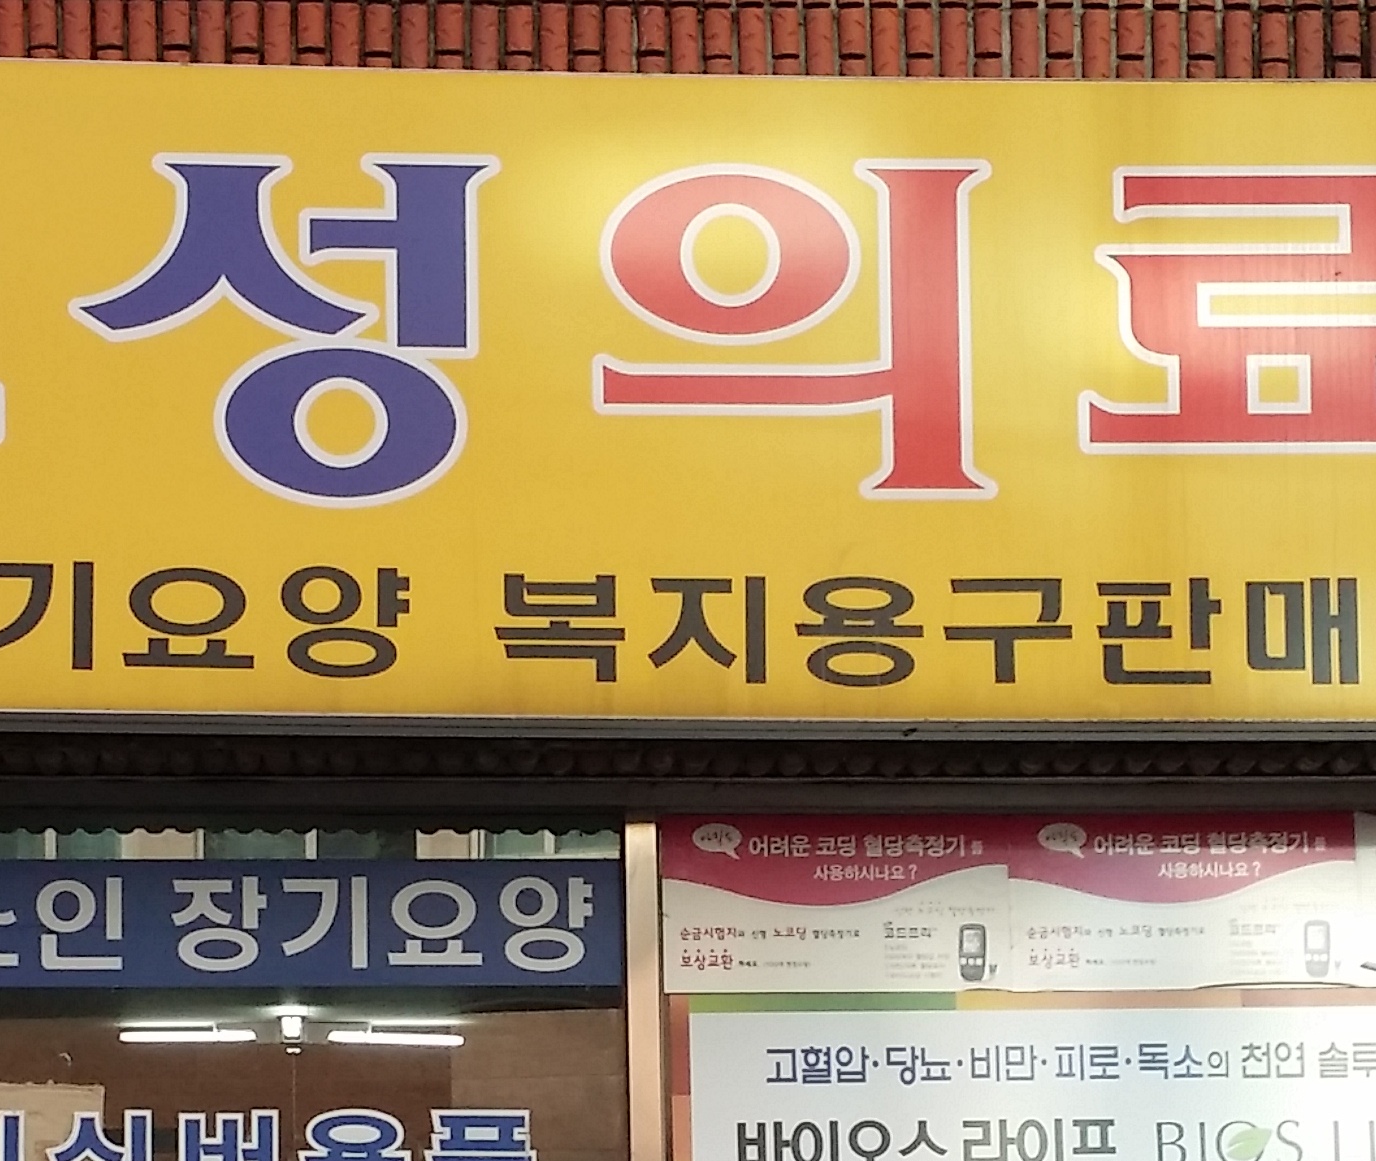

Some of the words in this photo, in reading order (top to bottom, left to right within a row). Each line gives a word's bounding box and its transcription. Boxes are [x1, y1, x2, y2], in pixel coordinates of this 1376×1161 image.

[749, 835, 812, 857] 어려운
[816, 835, 856, 857] 코딩
[1094, 834, 1154, 855] 어려운
[1160, 833, 1200, 855] 코딩
[171, 875, 594, 973] 장기요양
[1241, 1041, 1305, 1079] 천연
